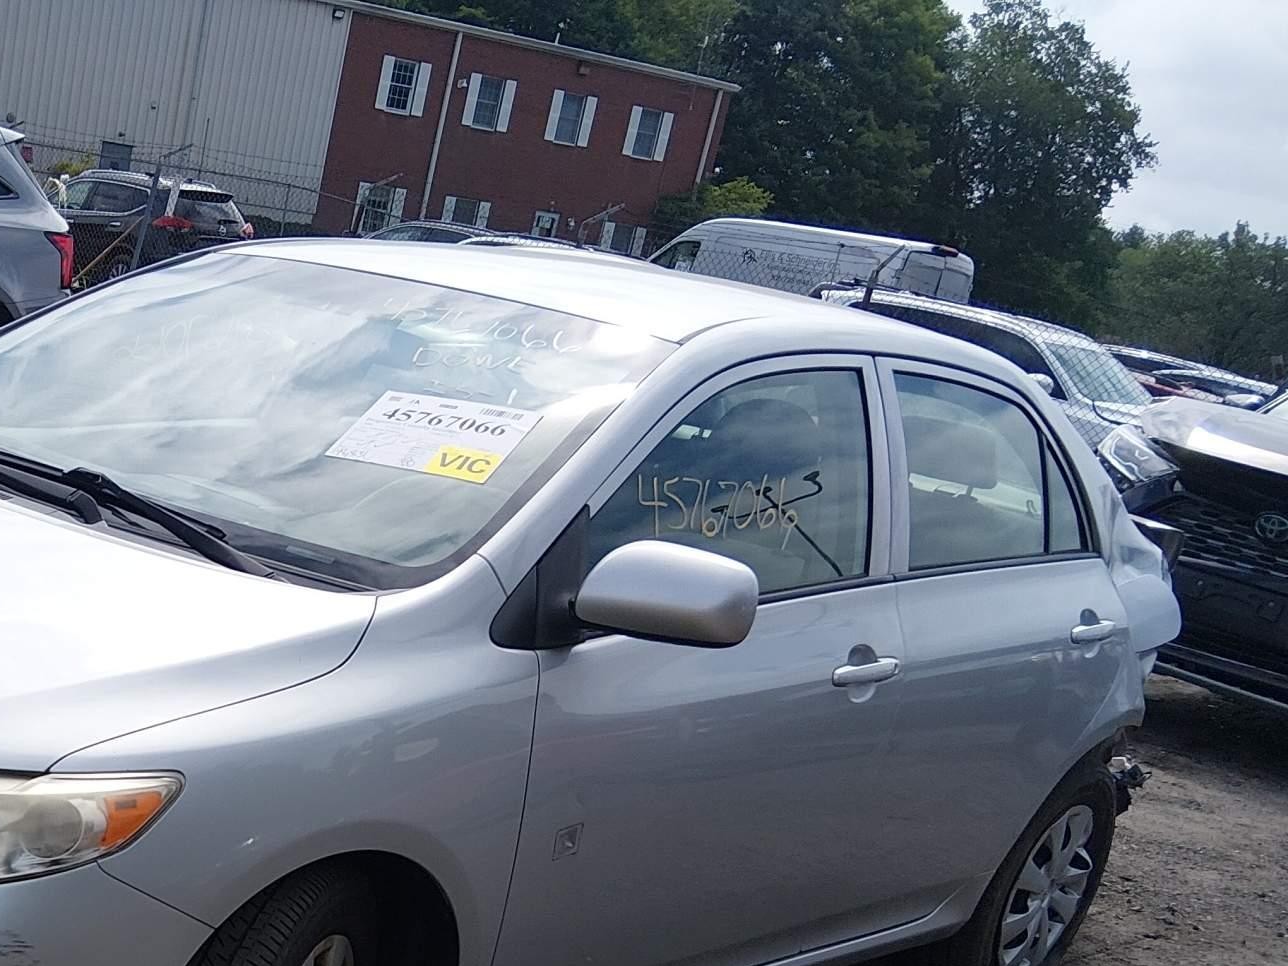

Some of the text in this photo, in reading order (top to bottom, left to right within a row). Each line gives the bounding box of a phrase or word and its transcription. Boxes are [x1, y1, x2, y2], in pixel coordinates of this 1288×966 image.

[382, 407, 511, 437] 45767066
[439, 452, 491, 474] VIC
[636, 473, 799, 551] 45767066
